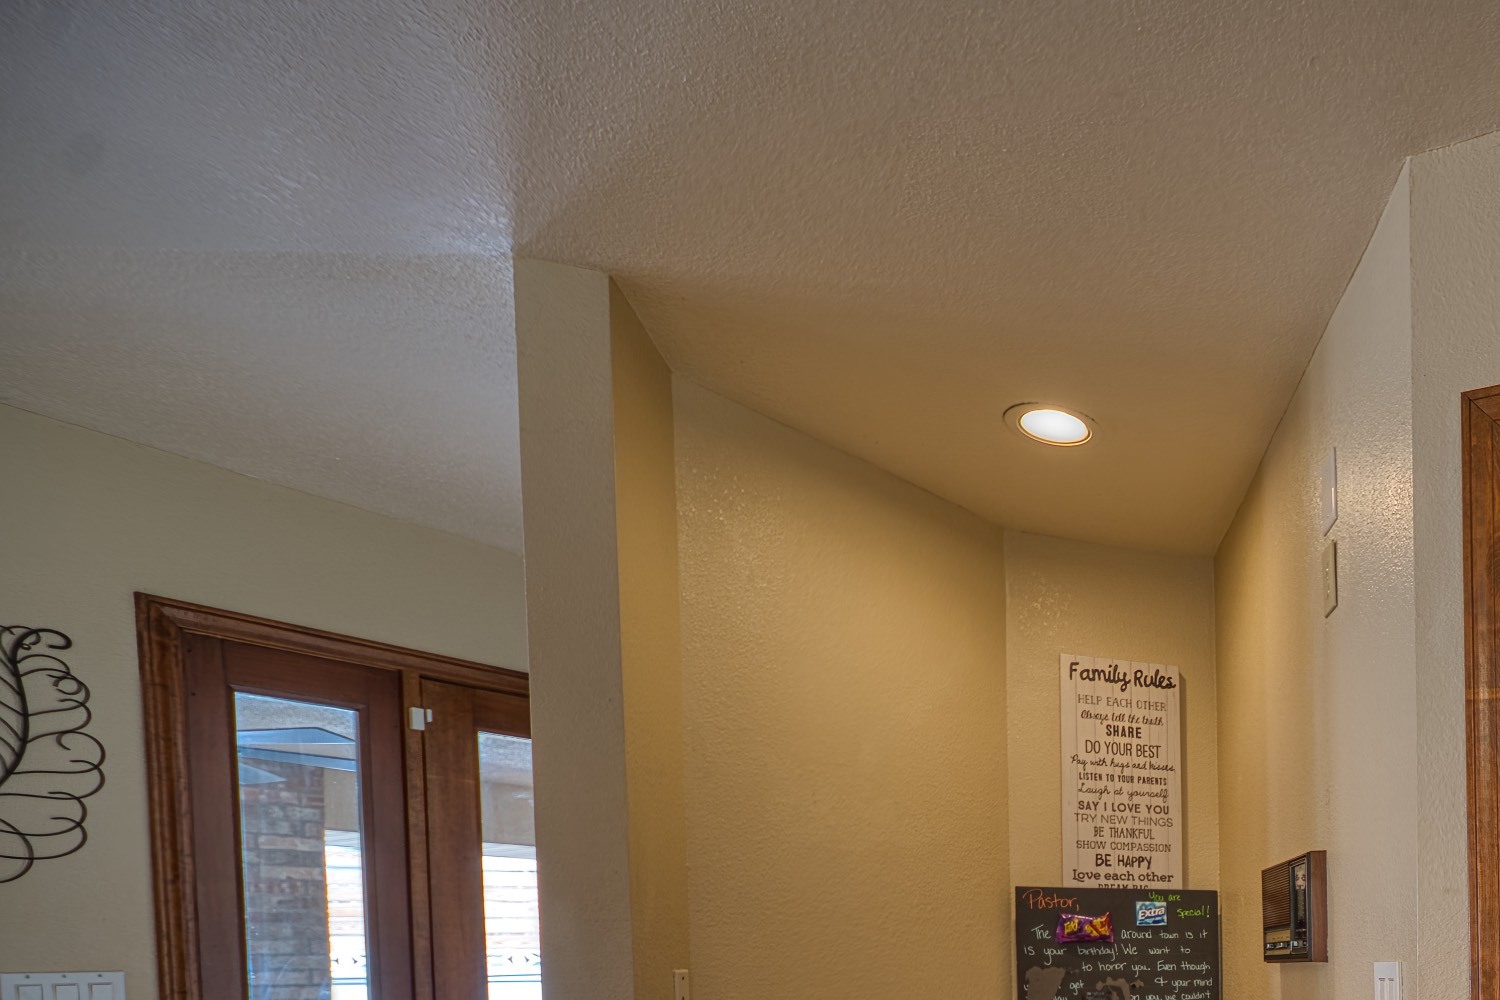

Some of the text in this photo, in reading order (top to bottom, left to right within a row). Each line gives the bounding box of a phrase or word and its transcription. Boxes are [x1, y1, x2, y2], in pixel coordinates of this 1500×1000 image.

[1069, 661, 1177, 692] Family Rules
[1077, 694, 1167, 711] HELP EACH OTHER
[1081, 709, 1164, 726] Always tell the truth
[1105, 724, 1142, 738] SHARE
[1085, 739, 1162, 758] DO YOUR BEST
[1090, 757, 1108, 767] with
[1110, 758, 1130, 774] hugs
[1132, 761, 1147, 770] and
[1148, 761, 1176, 772] kisses
[1078, 772, 1168, 786] LISTEN TO YOUR PARENTS
[1078, 782, 1169, 803] Laugh at yourself
[1078, 800, 1170, 815] SAY I LOVE YOU
[1074, 812, 1174, 828] TRY NEW THINGS
[1093, 826, 1155, 840] BE THANKFUL
[1076, 840, 1172, 853] SHOW COMPASSION
[1095, 853, 1152, 870] BE HAPPY
[1072, 869, 1174, 882] Love each other
[1022, 888, 1080, 912] Pastor,
[1148, 891, 1164, 902] You
[1138, 907, 1166, 920] Extra
[1030, 924, 1052, 940] The
[1121, 929, 1208, 939] around town is it
[1023, 943, 1191, 966] is your birthday! We want to
[1081, 960, 1211, 978] to honor you. Even though
[1069, 980, 1085, 996] get
[1171, 981, 1192, 993] your
[1193, 977, 1213, 987] mind
